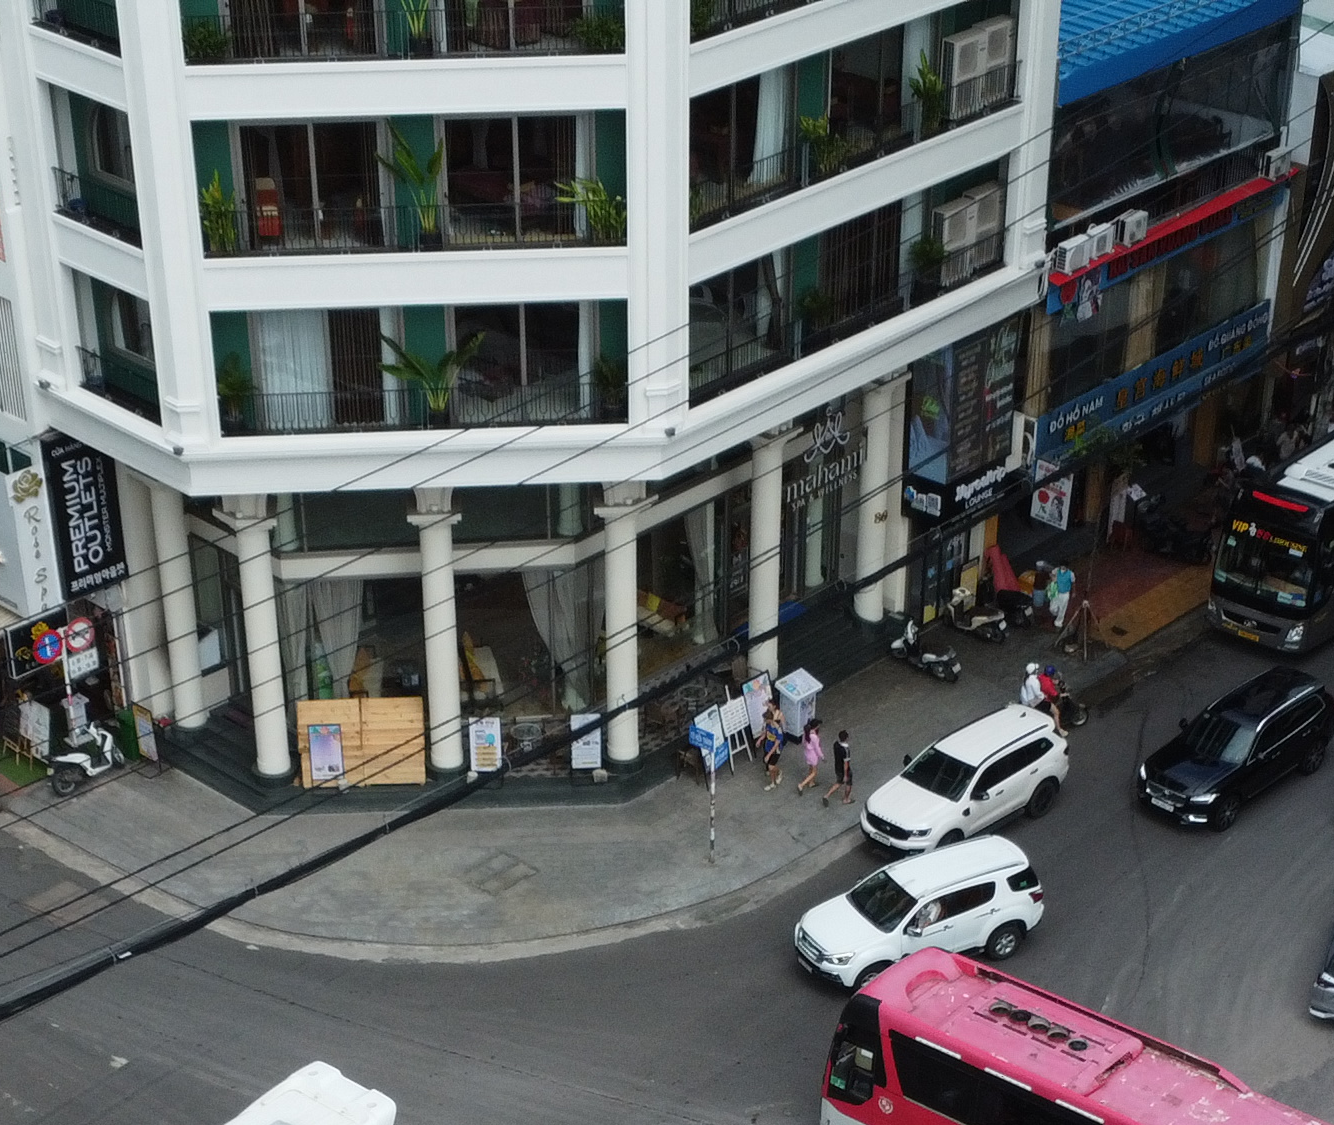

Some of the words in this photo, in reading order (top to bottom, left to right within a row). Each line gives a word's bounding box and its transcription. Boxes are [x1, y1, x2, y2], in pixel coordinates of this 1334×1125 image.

[1081, 396, 1104, 417] NAM
[786, 442, 864, 503] mahami
[60, 458, 90, 573] PREMIUM
[76, 456, 104, 564] OUTLETS
[965, 487, 993, 510] LOUNGE
[1232, 519, 1250, 533] VIP
